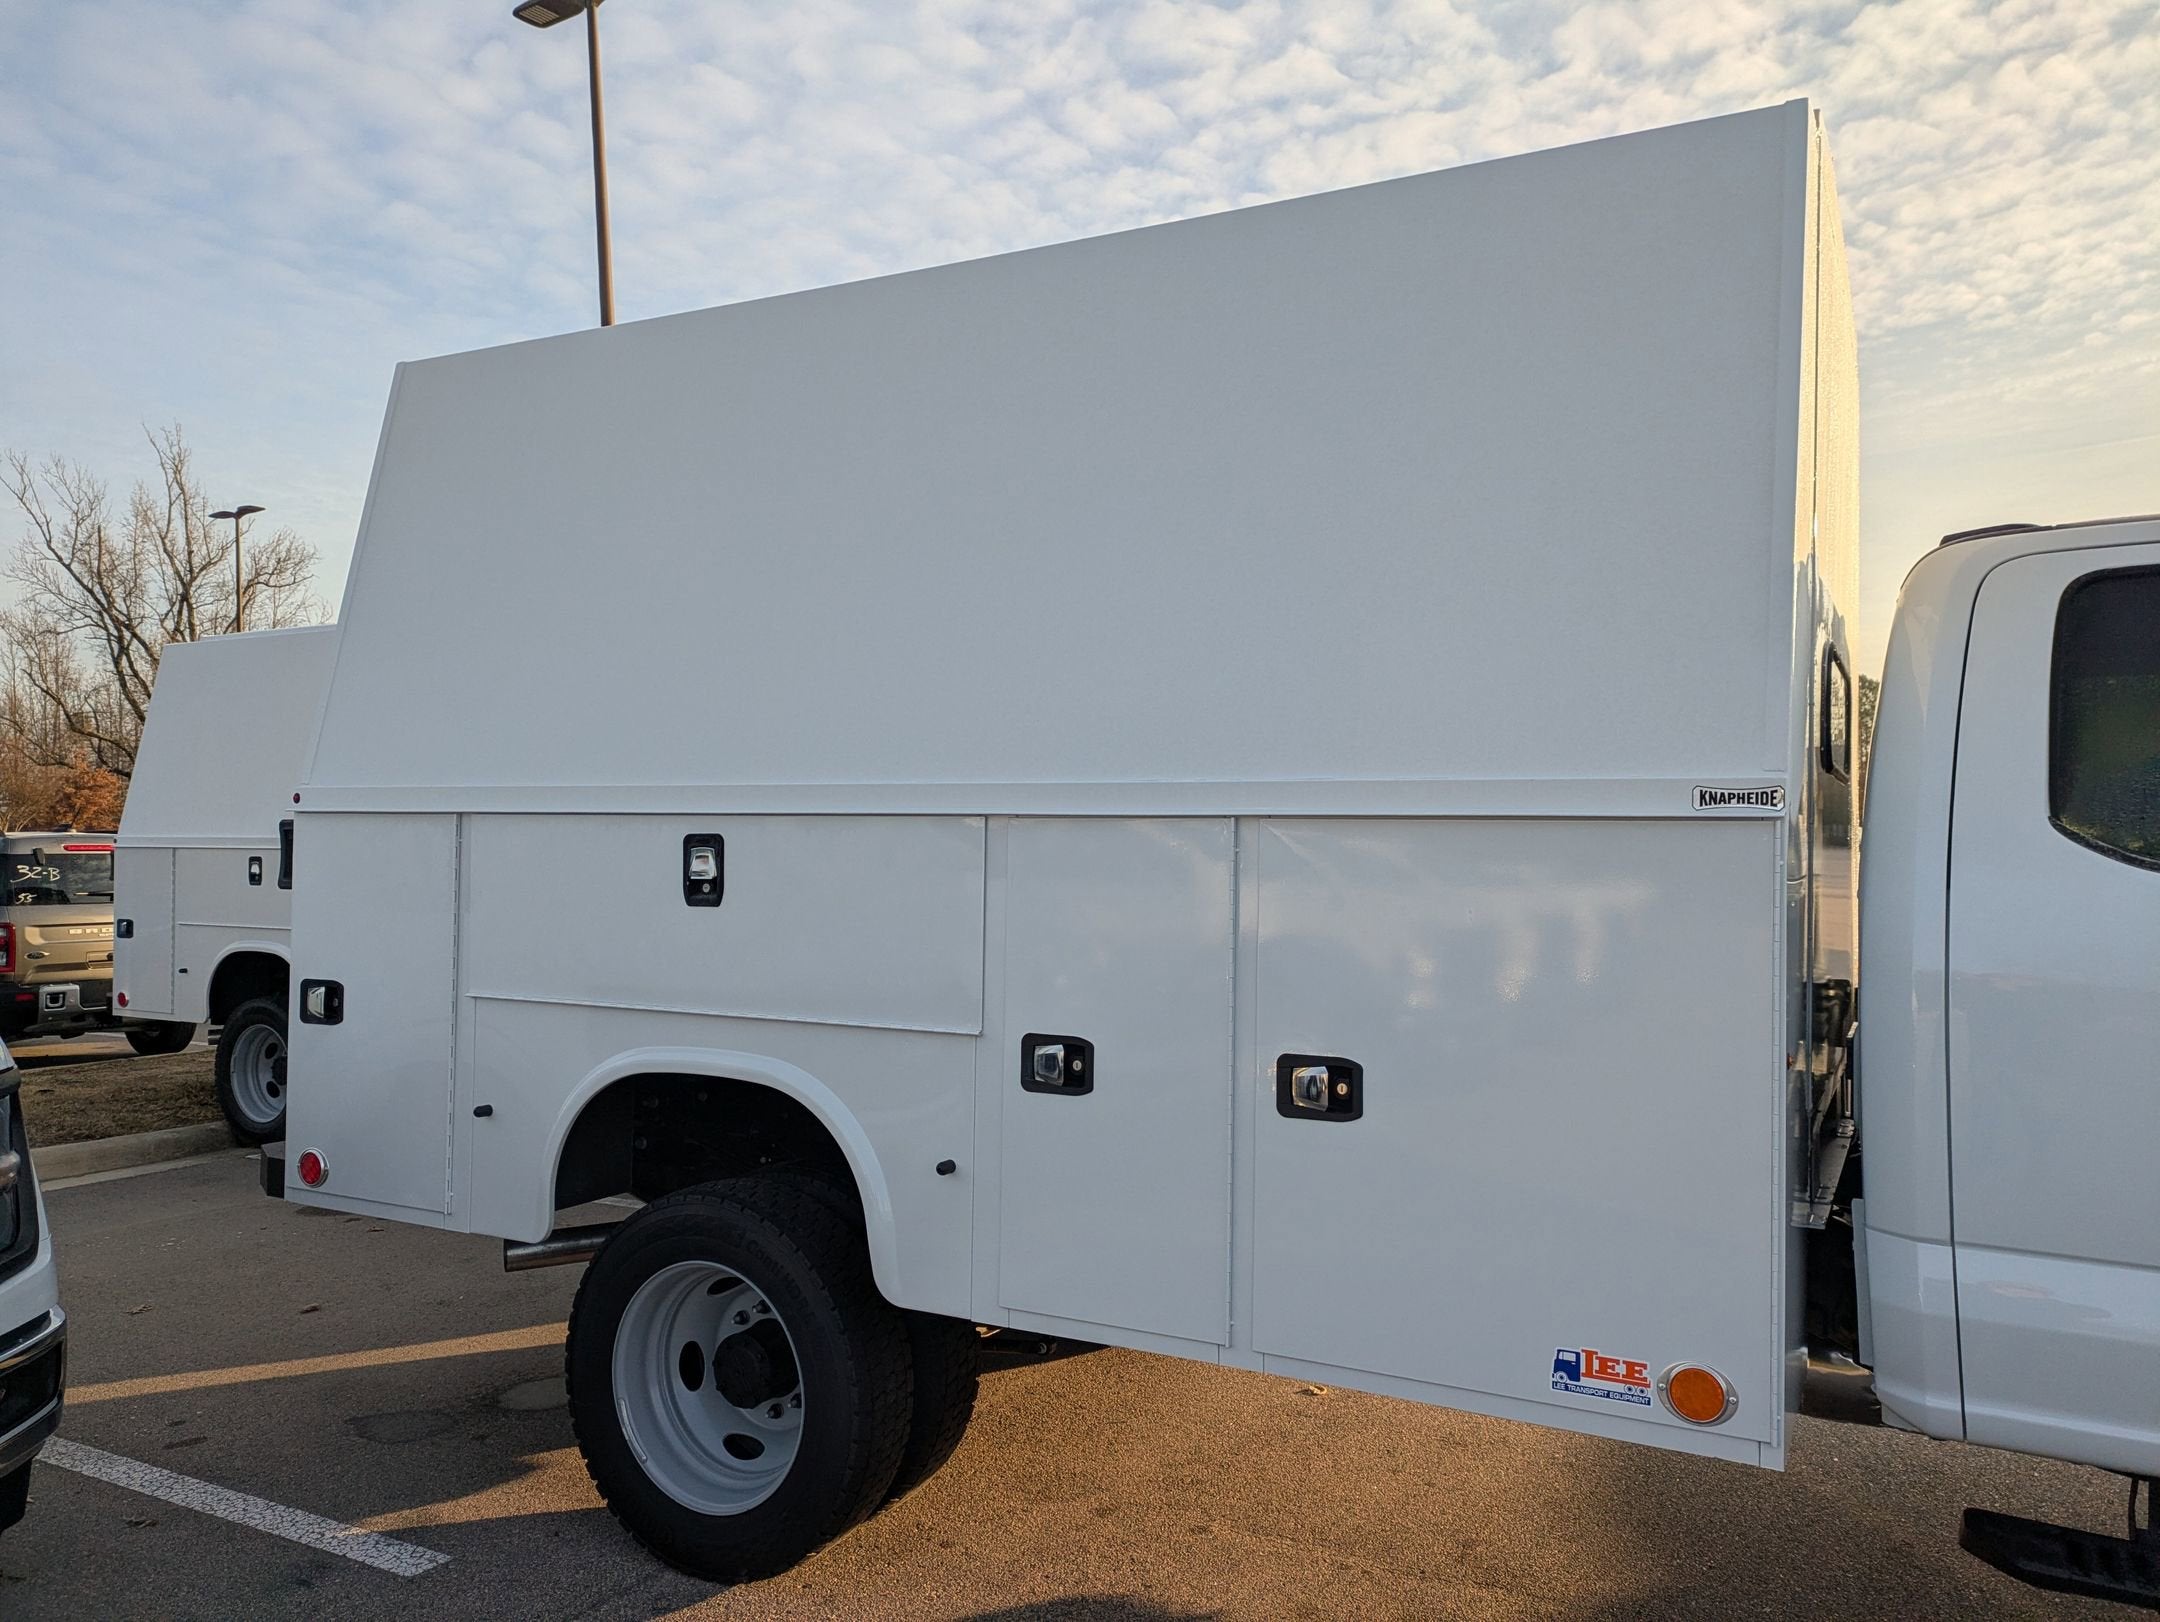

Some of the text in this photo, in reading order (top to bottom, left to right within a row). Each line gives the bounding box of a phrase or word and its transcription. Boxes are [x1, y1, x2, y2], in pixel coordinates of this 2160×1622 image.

[1699, 789, 1778, 807] KNAPHEIDE
[10, 864, 61, 883] 32-B
[1581, 1348, 1651, 1388] LEE
[1553, 1381, 1650, 1405] LEE TRANSPORT EQUIPMENT
